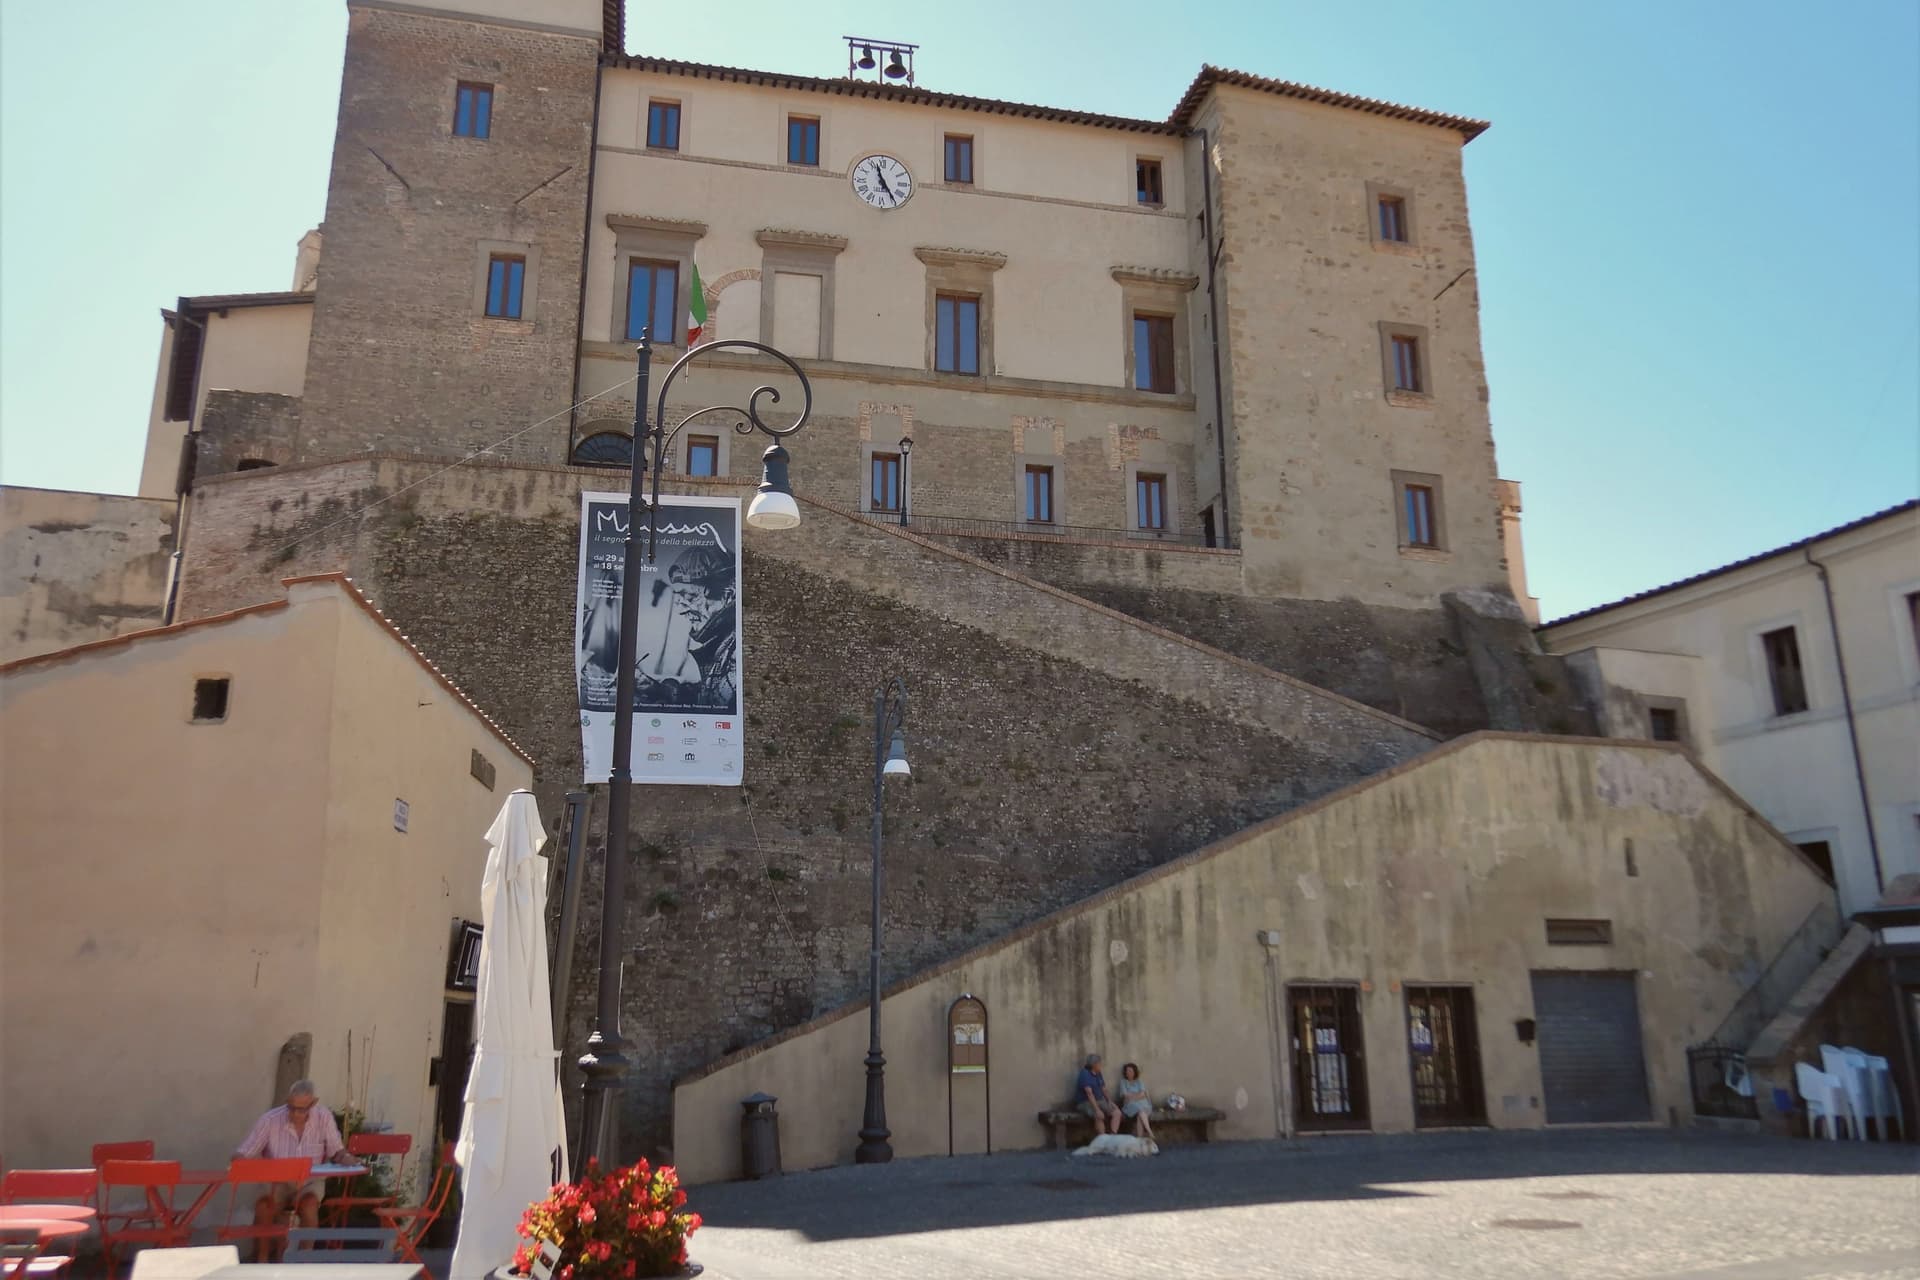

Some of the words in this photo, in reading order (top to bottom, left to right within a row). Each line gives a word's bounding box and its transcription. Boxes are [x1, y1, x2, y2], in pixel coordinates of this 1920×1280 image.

[660, 537, 680, 545] della
[605, 554, 617, 562] 29
[601, 562, 612, 570] 18
